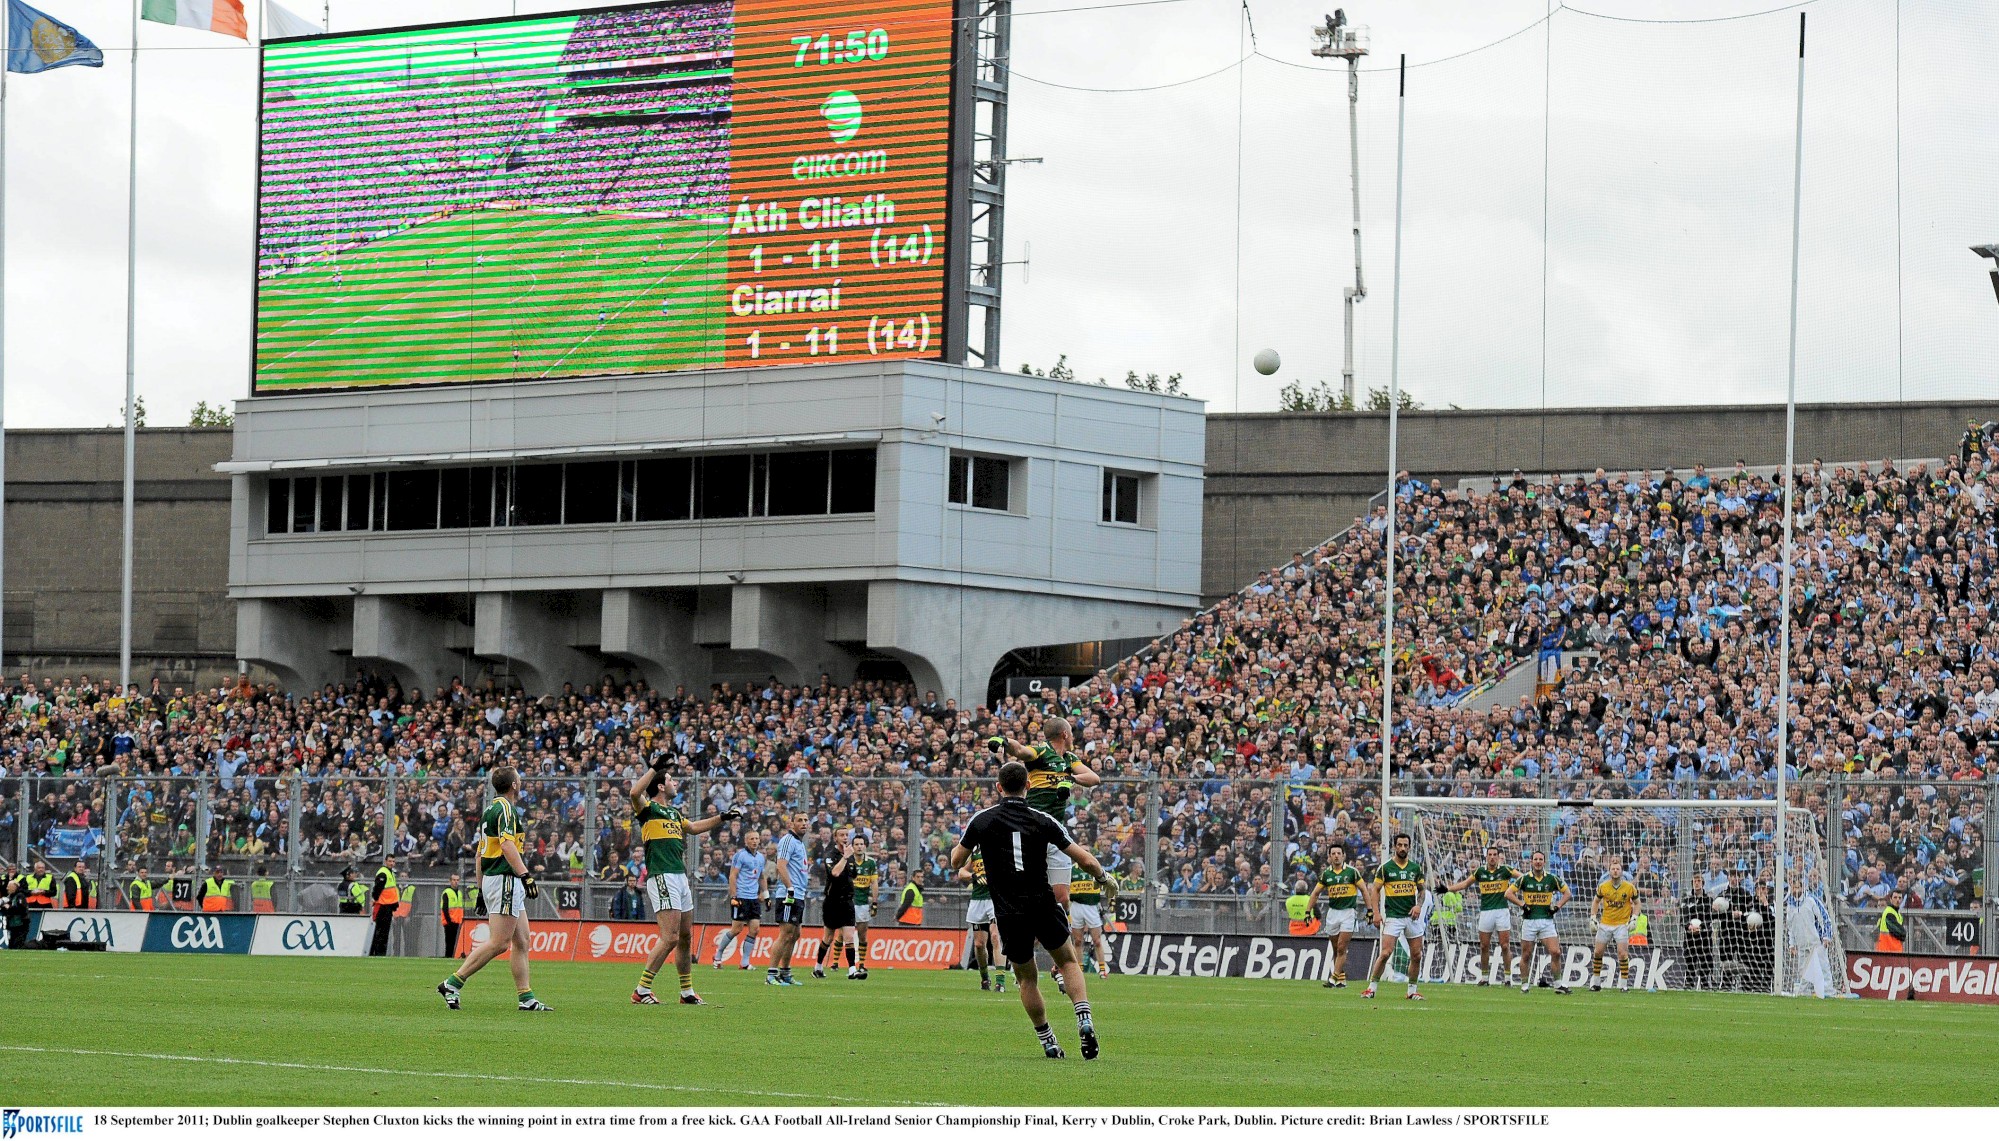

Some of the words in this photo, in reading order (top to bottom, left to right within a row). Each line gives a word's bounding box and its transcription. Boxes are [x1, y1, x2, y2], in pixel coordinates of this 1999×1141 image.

[790, 28, 889, 67] 71:50
[731, 196, 788, 235] Áth
[798, 194, 895, 230] Cliath
[749, 244, 762, 273] 1
[807, 240, 840, 270] 11
[870, 224, 933, 268] (14)
[731, 278, 842, 316] Ciarraí
[747, 330, 760, 358] 1
[805, 326, 838, 356] 11
[867, 312, 931, 355] (14)
[1029, 680, 1041, 692] C2
[1012, 832, 1024, 871] 1
[175, 882, 189, 899] 37
[562, 891, 577, 907] 38
[1119, 902, 1137, 920] 39
[171, 916, 224, 949] GAA
[282, 919, 335, 951] GAA
[1951, 922, 1975, 942] 40
[1119, 934, 1240, 977] Ulster
[1562, 946, 1674, 991] Bank
[1850, 957, 1999, 1000] SuperVal
